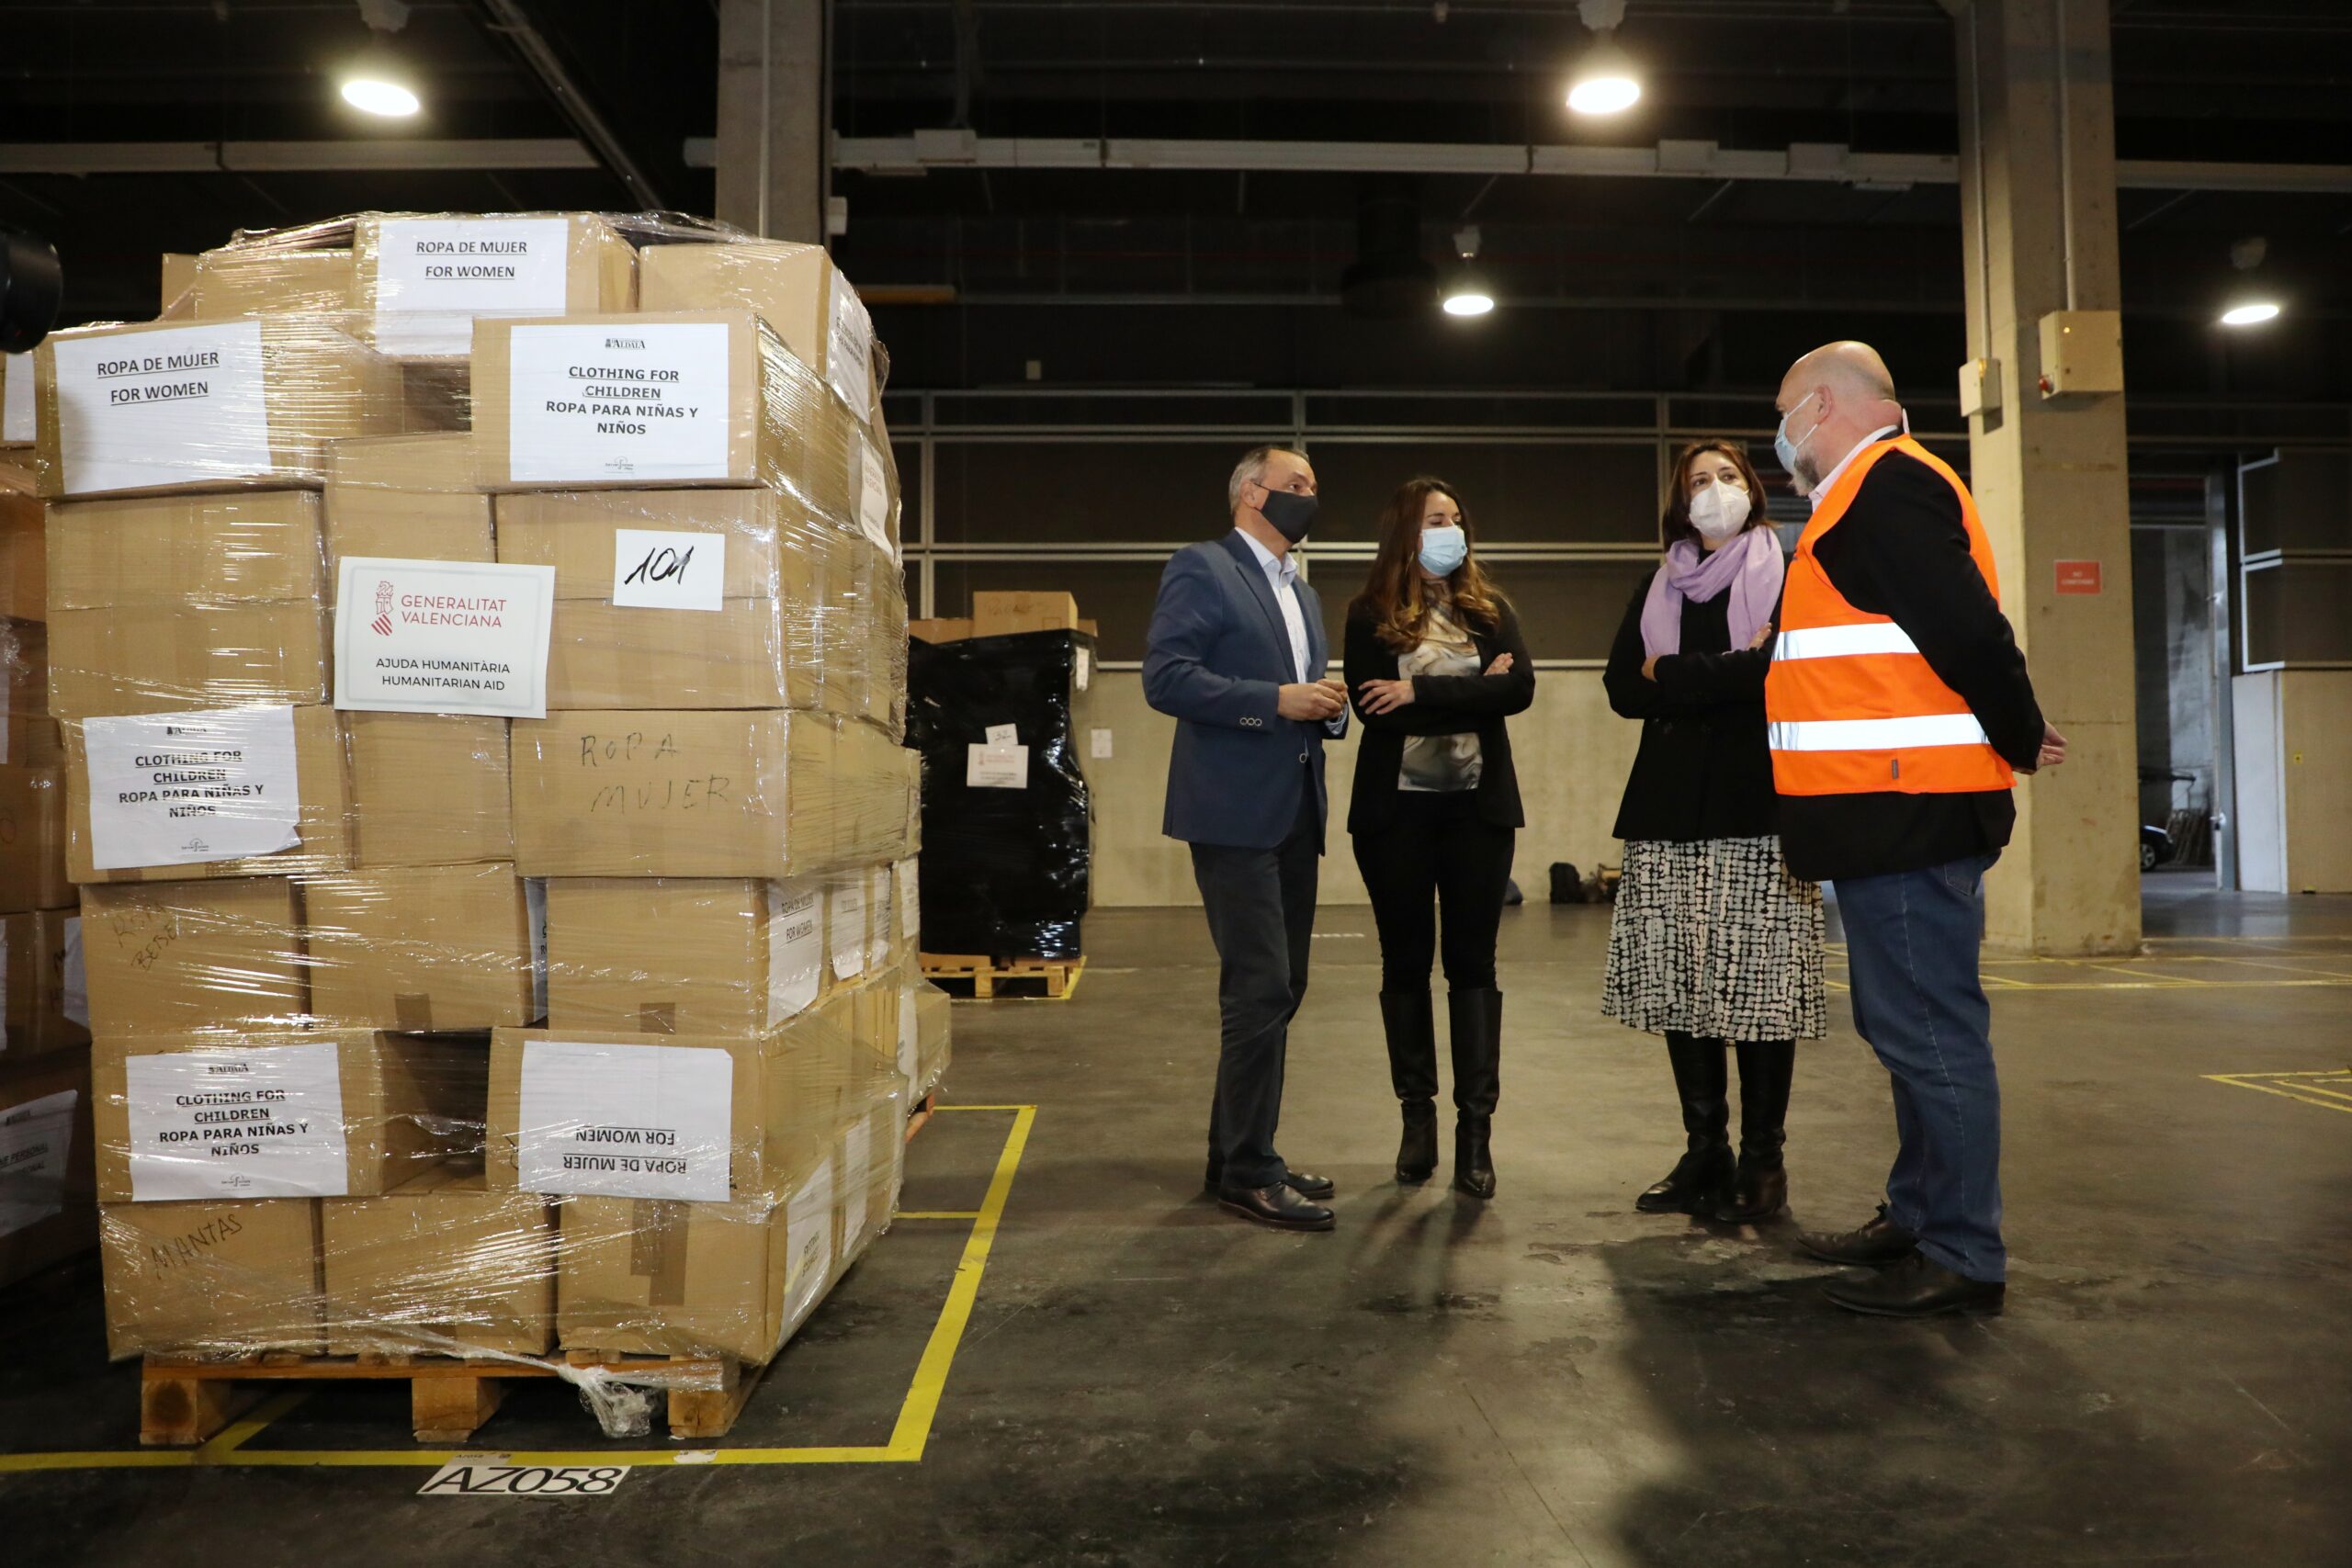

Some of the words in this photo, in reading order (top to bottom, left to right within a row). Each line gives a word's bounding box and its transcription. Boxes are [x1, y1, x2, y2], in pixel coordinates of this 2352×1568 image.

[416, 242, 454, 253] ROPA
[459, 242, 476, 253] DE
[480, 242, 527, 253] MUJER
[425, 266, 453, 277] FOR
[457, 266, 514, 277] WOMEN
[97, 360, 139, 376] ROPA
[143, 357, 163, 371] DE
[167, 352, 220, 368] MUJER
[569, 367, 645, 380] CLOTHING
[650, 369, 680, 381] FOR
[110, 389, 141, 402] FOR
[144, 381, 209, 400] WOMEN
[584, 386, 662, 399] CHILDREN
[546, 400, 587, 414] ROPA
[592, 404, 631, 416] PARA
[636, 403, 684, 418] NIÑAS
[689, 407, 698, 418] Y
[597, 421, 646, 434] NIÑOS
[401, 594, 507, 612] GENERALITAT
[401, 611, 502, 627] VALENCIANA
[376, 658, 419, 669] AJUDA
[422, 660, 510, 673] HUMANITÀRIA
[382, 675, 481, 689] HUMANITARIAN
[483, 681, 505, 691] AID
[581, 732, 677, 767] ROPA
[135, 752, 209, 767] CLOTHING
[213, 750, 243, 762] FOR
[153, 769, 227, 784] CHILDREN
[119, 791, 158, 803] ROPA
[163, 789, 199, 801] PARA
[204, 784, 250, 798] NIÑAS
[254, 784, 264, 795] Y
[591, 773, 730, 814] MUJER
[169, 804, 216, 818] NIÑOS
[176, 1091, 252, 1106] CLOTHING
[256, 1089, 286, 1101] FOR
[194, 1108, 270, 1122] CHILDREN
[159, 1130, 198, 1143] ROPA
[203, 1127, 243, 1140] PARA
[247, 1122, 295, 1136] NIÑAS
[300, 1123, 309, 1134] Y
[576, 1129, 640, 1144] WOMEN
[646, 1132, 675, 1145] FOR
[211, 1143, 259, 1156] NIÑOS
[563, 1156, 615, 1170] MUJER
[620, 1157, 640, 1172] DE
[645, 1159, 687, 1174] ROPA
[151, 1213, 243, 1280] MANTAS
[421, 1466, 623, 1494] AZ058
